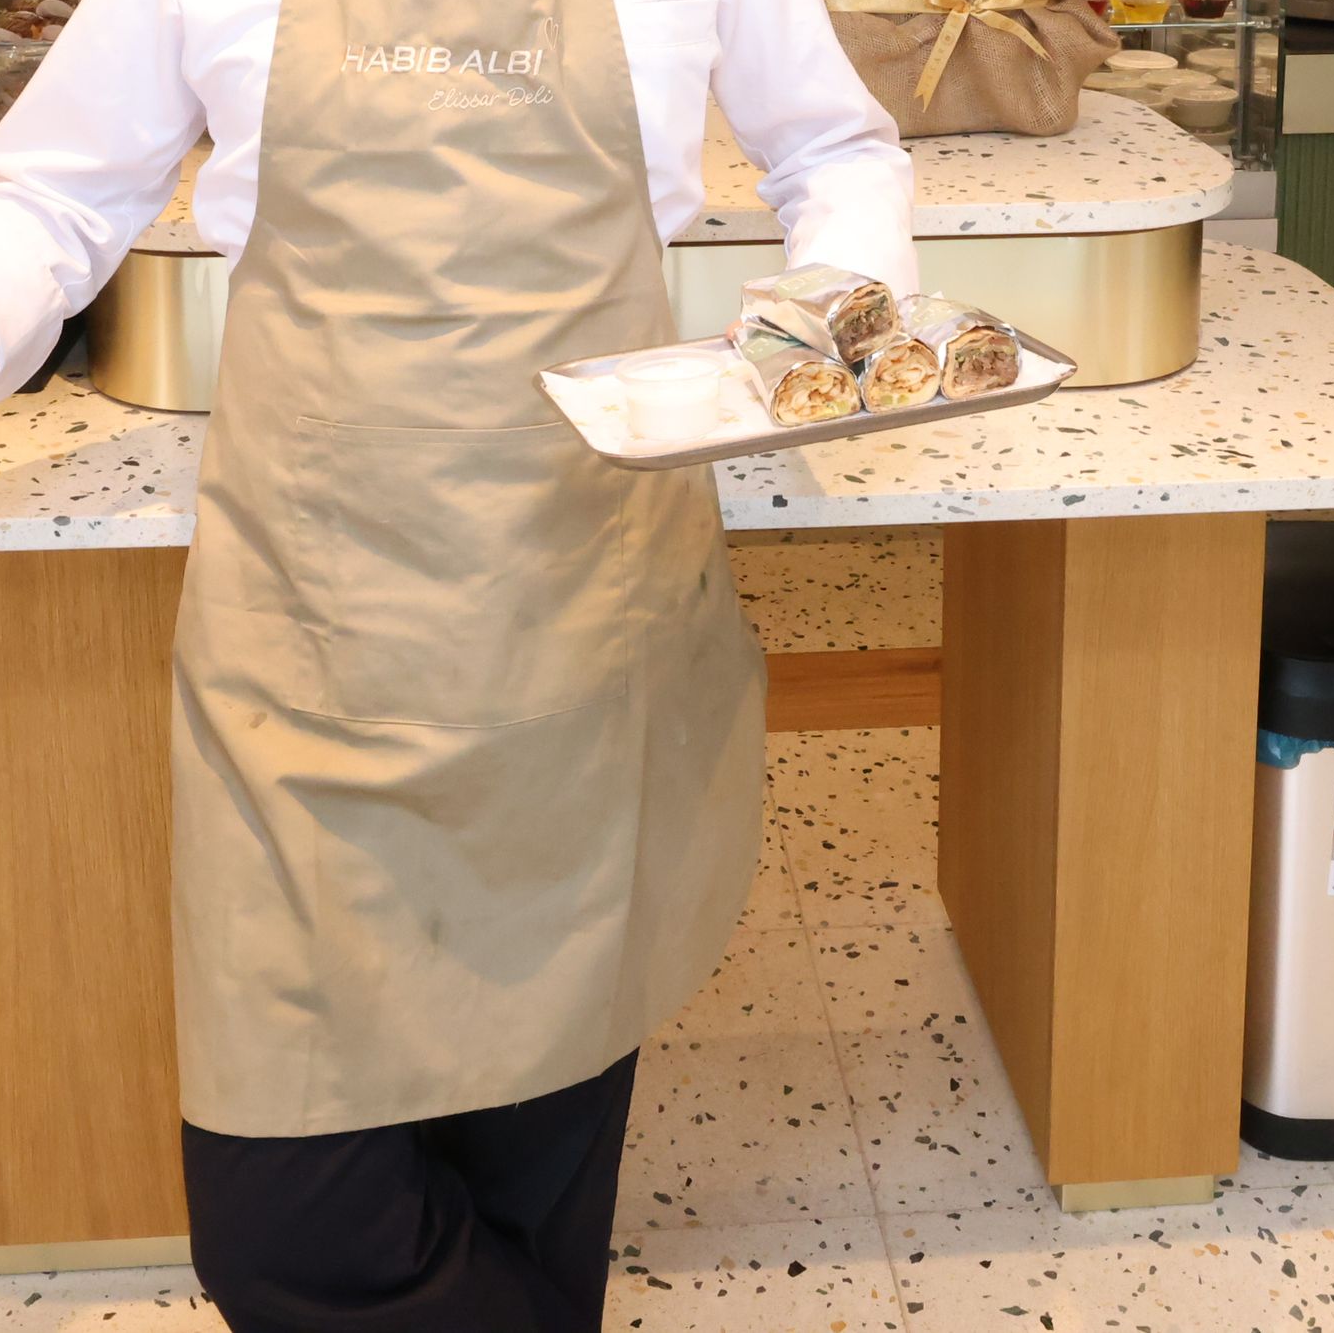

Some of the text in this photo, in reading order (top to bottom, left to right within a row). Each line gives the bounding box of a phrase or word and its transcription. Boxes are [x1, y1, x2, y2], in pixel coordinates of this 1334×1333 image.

[341, 45, 543, 75] HABIB ALBI
[428, 86, 553, 111] Elissar Deli
